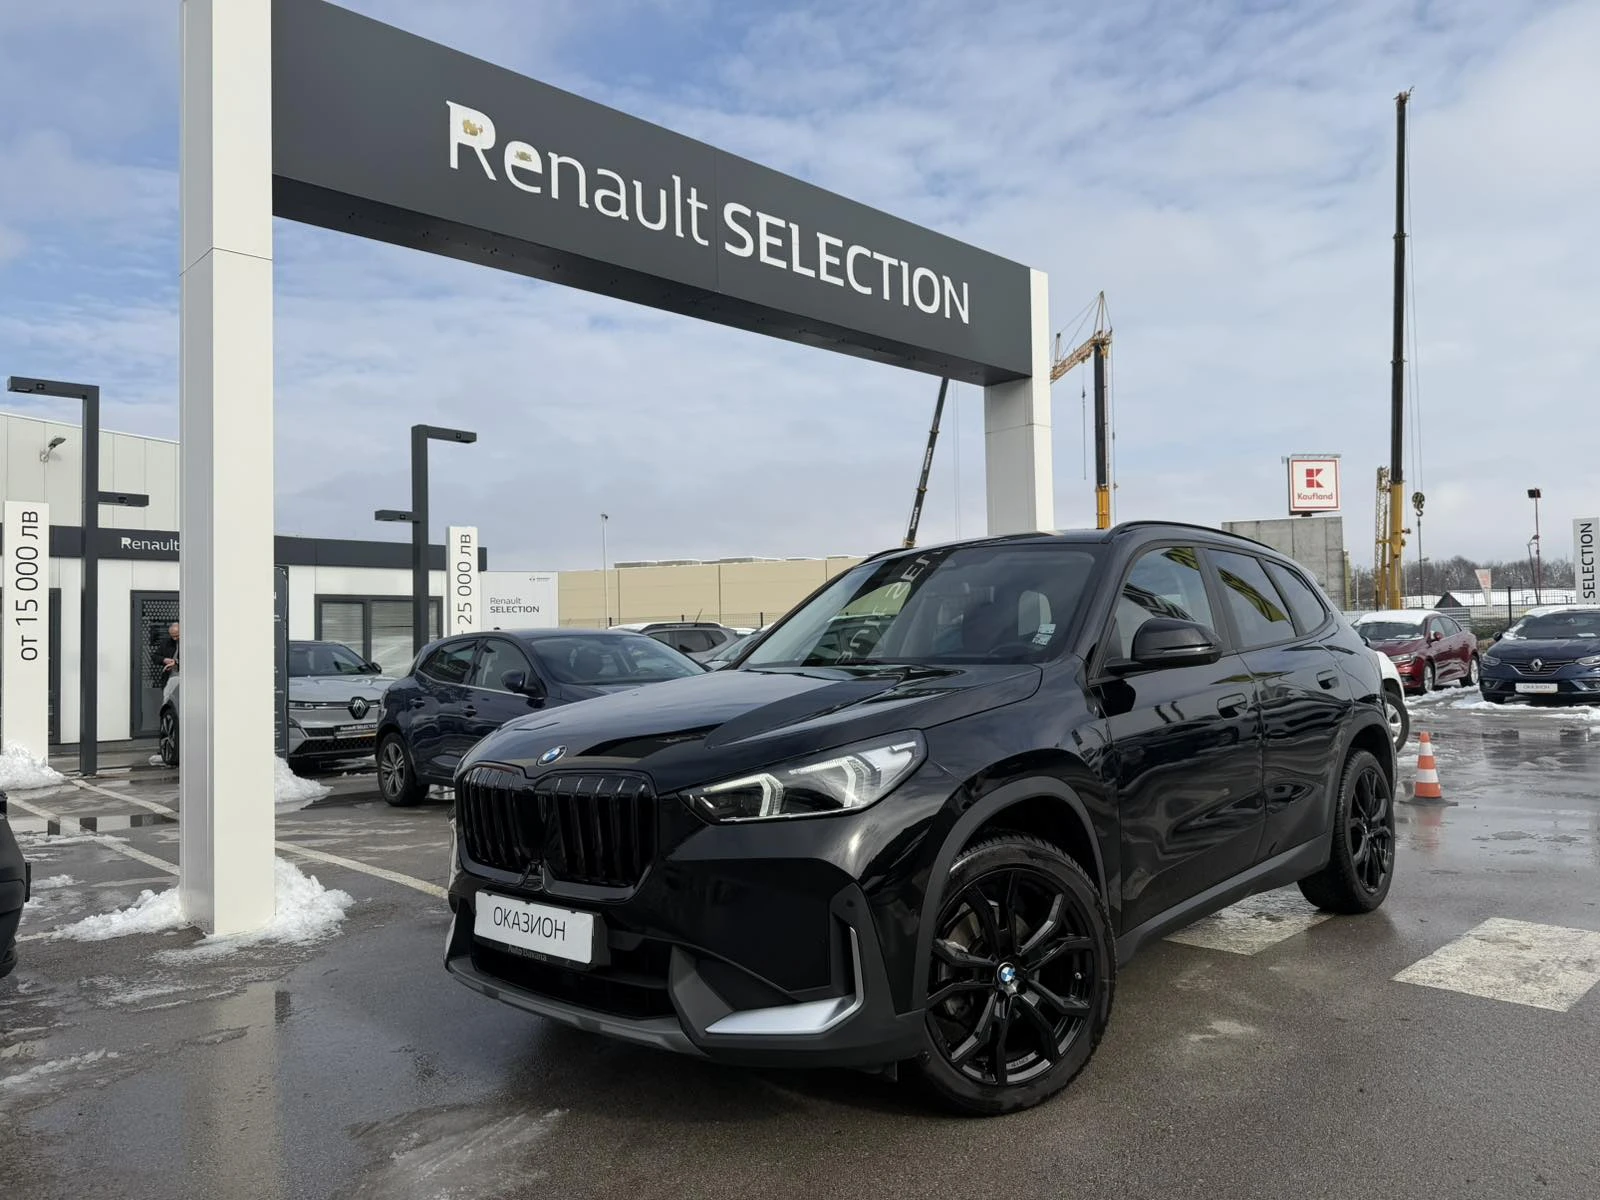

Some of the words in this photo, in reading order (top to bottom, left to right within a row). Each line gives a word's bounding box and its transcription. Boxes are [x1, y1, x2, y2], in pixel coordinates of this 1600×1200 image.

[446, 100, 709, 246] Renault
[723, 202, 969, 325] SELECTION
[1297, 492, 1334, 500] Kaufland
[120, 536, 180, 551] Renault
[15, 546, 39, 591] 000
[1579, 523, 1596, 599] SELECTION
[456, 561, 472, 597] 000
[15, 599, 39, 626] 15
[457, 602, 472, 625] 25
[489, 597, 522, 605] Renault
[489, 605, 540, 613] SELECTION
[493, 906, 566, 941] ОКАЗИОН
